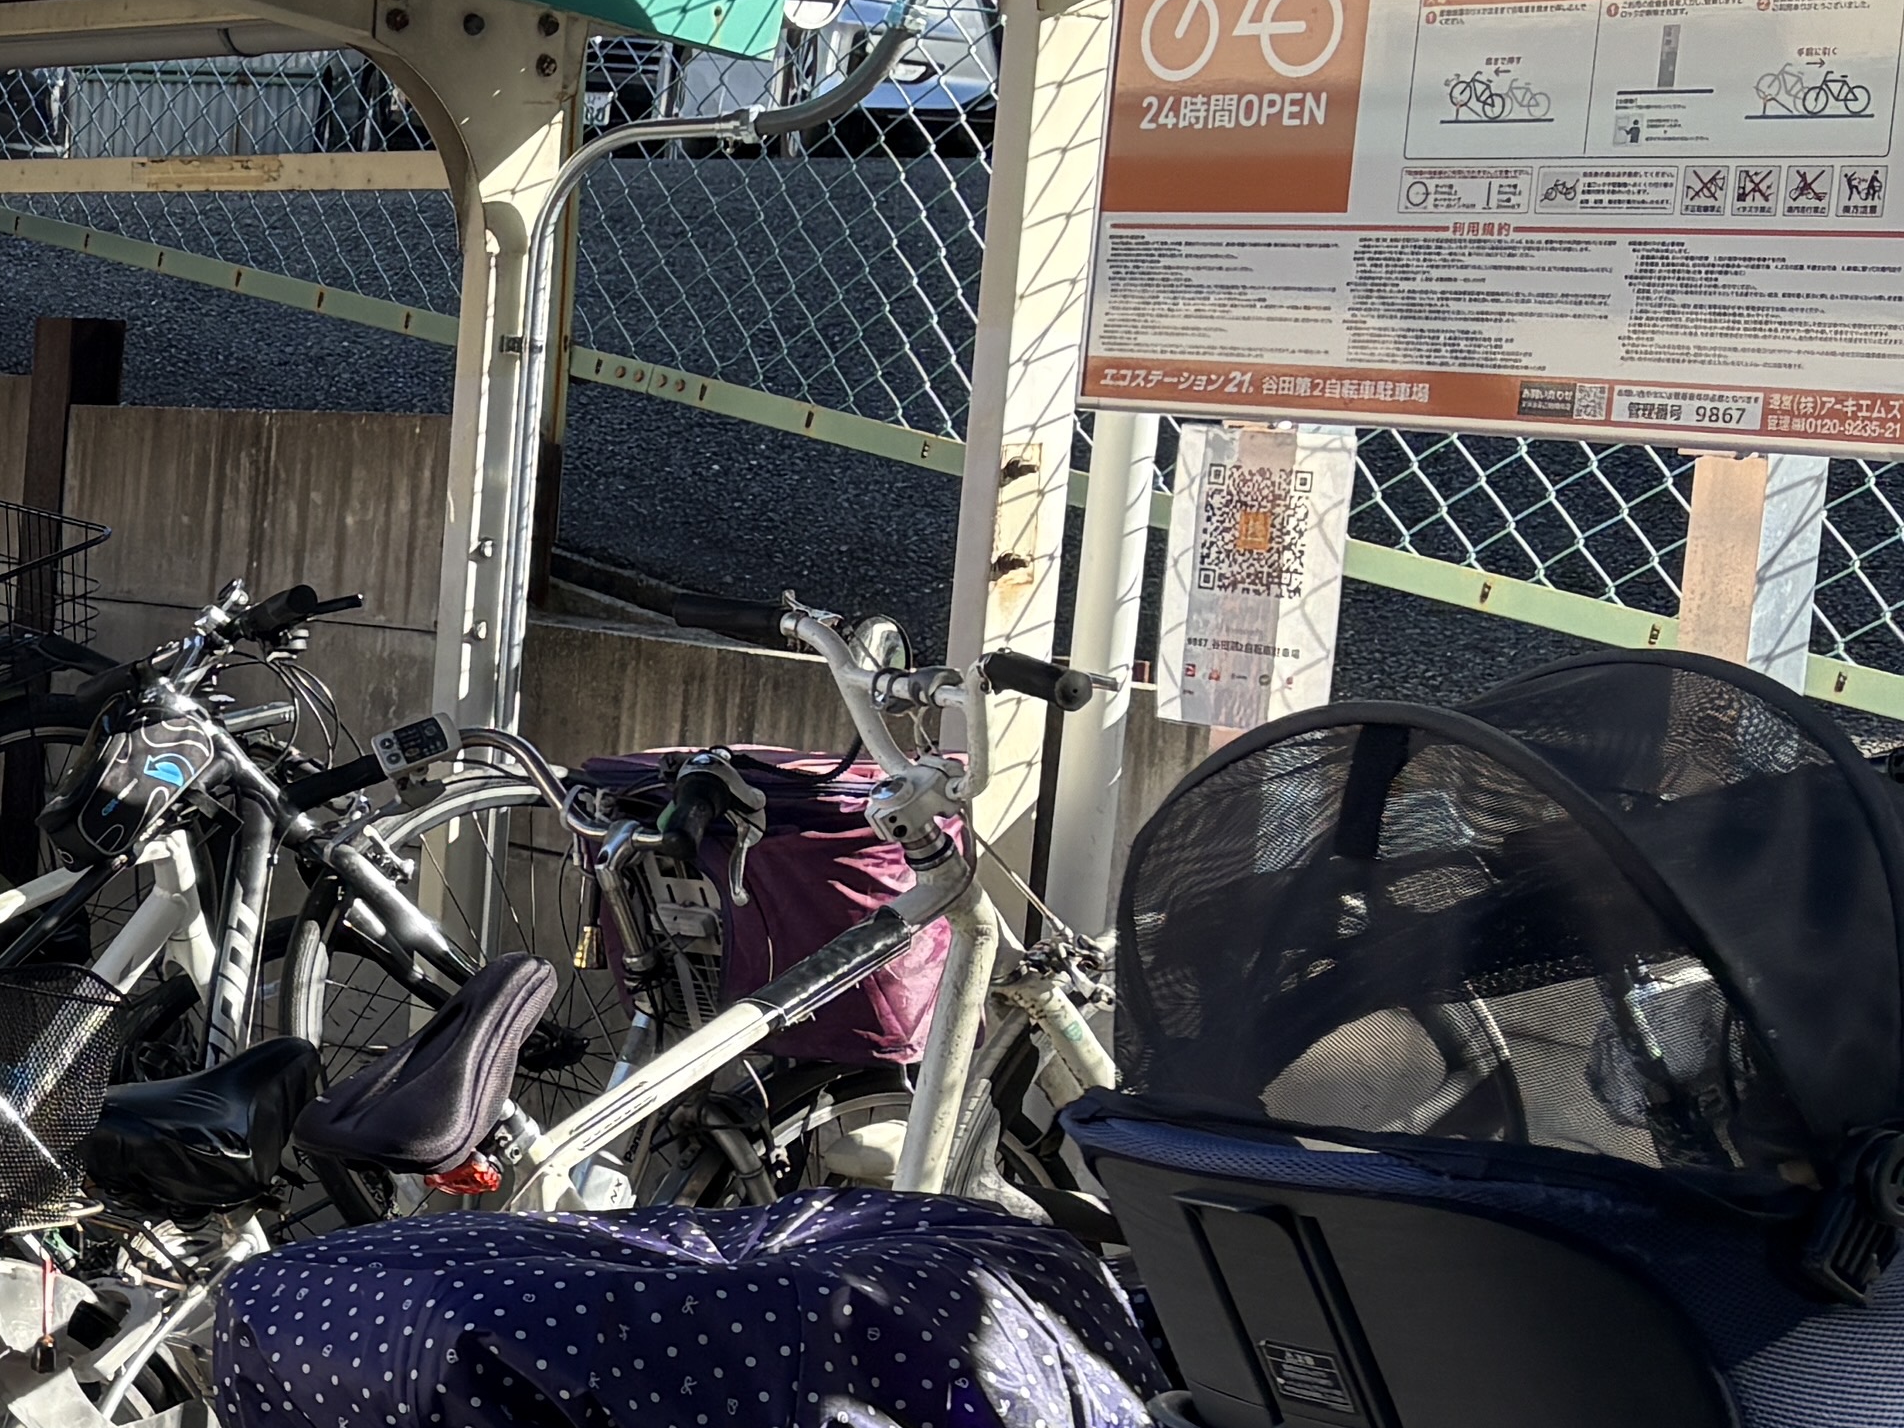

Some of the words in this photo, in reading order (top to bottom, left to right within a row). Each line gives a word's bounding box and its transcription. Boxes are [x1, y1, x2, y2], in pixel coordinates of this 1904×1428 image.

[1140, 92, 1327, 129] 24時間OPEN
[1451, 222, 1512, 237] 利用規約
[1627, 402, 1682, 421] 管理番号
[1695, 405, 1747, 425] 9867
[1806, 419, 1901, 438] 0120-9235-21
